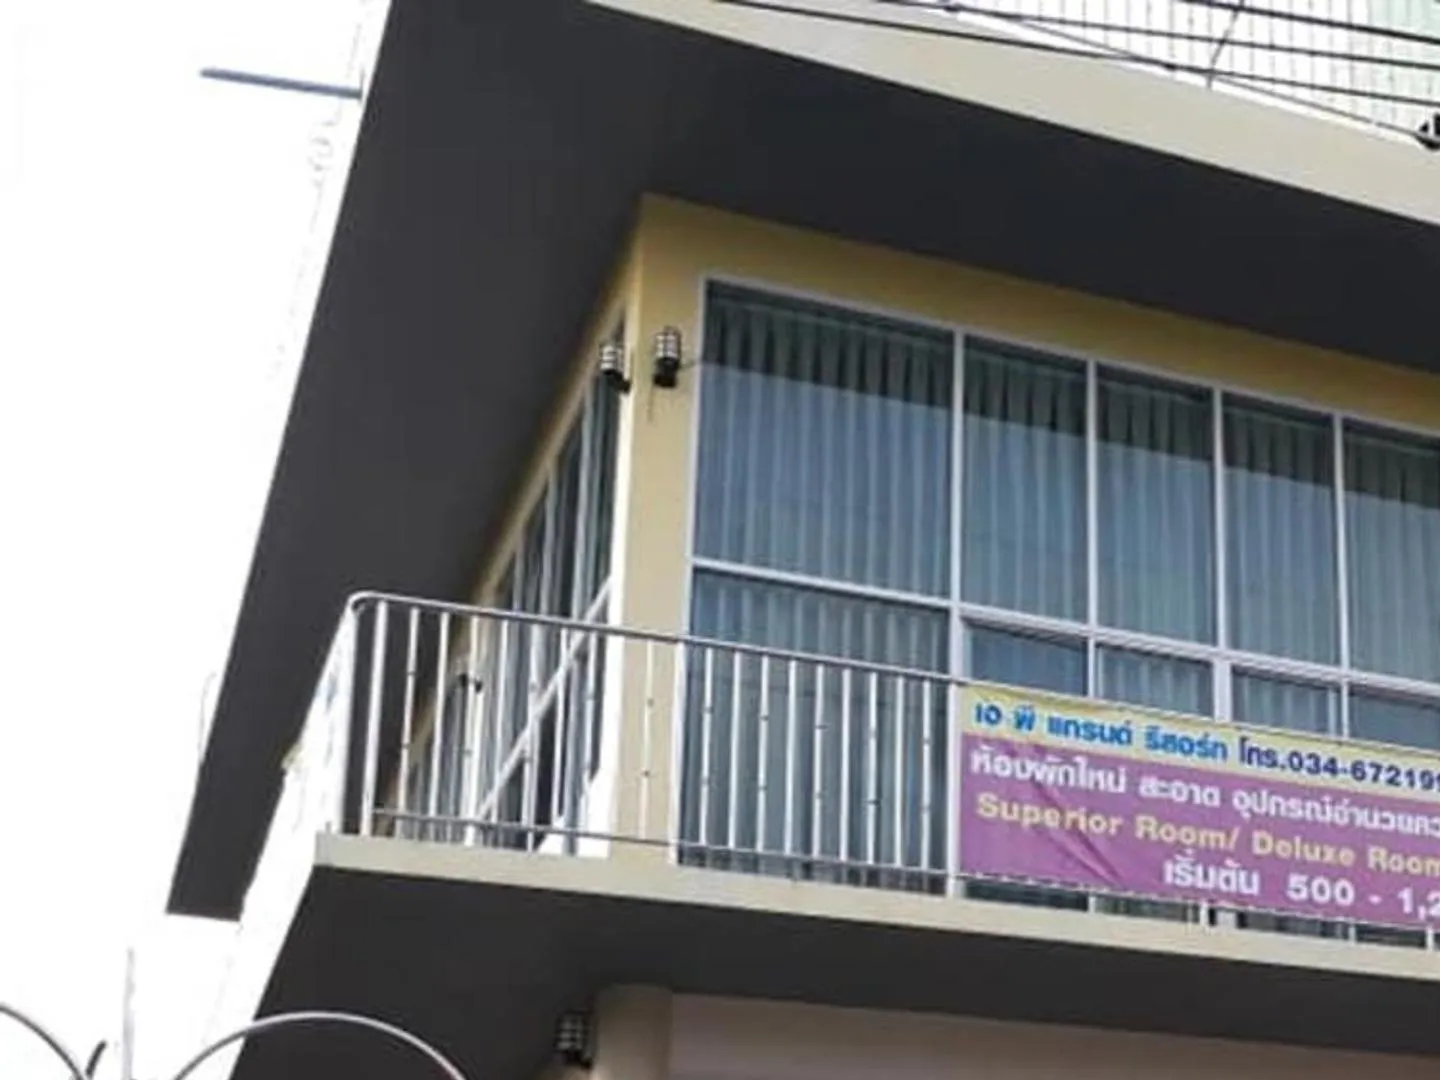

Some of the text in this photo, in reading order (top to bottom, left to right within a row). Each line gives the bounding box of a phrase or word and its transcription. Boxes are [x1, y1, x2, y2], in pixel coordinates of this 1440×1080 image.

[975, 703, 1003, 726] เอ
[1047, 718, 1133, 746] แกรนด์
[970, 743, 1127, 793] ห้องพักใหม่
[1139, 775, 1221, 809] สะอาด
[977, 791, 1123, 836] Superior
[1135, 813, 1240, 850] Room/
[1252, 829, 1355, 866] Deluxe
[1163, 848, 1260, 896] เริ่มต้น
[1286, 872, 1356, 906] 500
